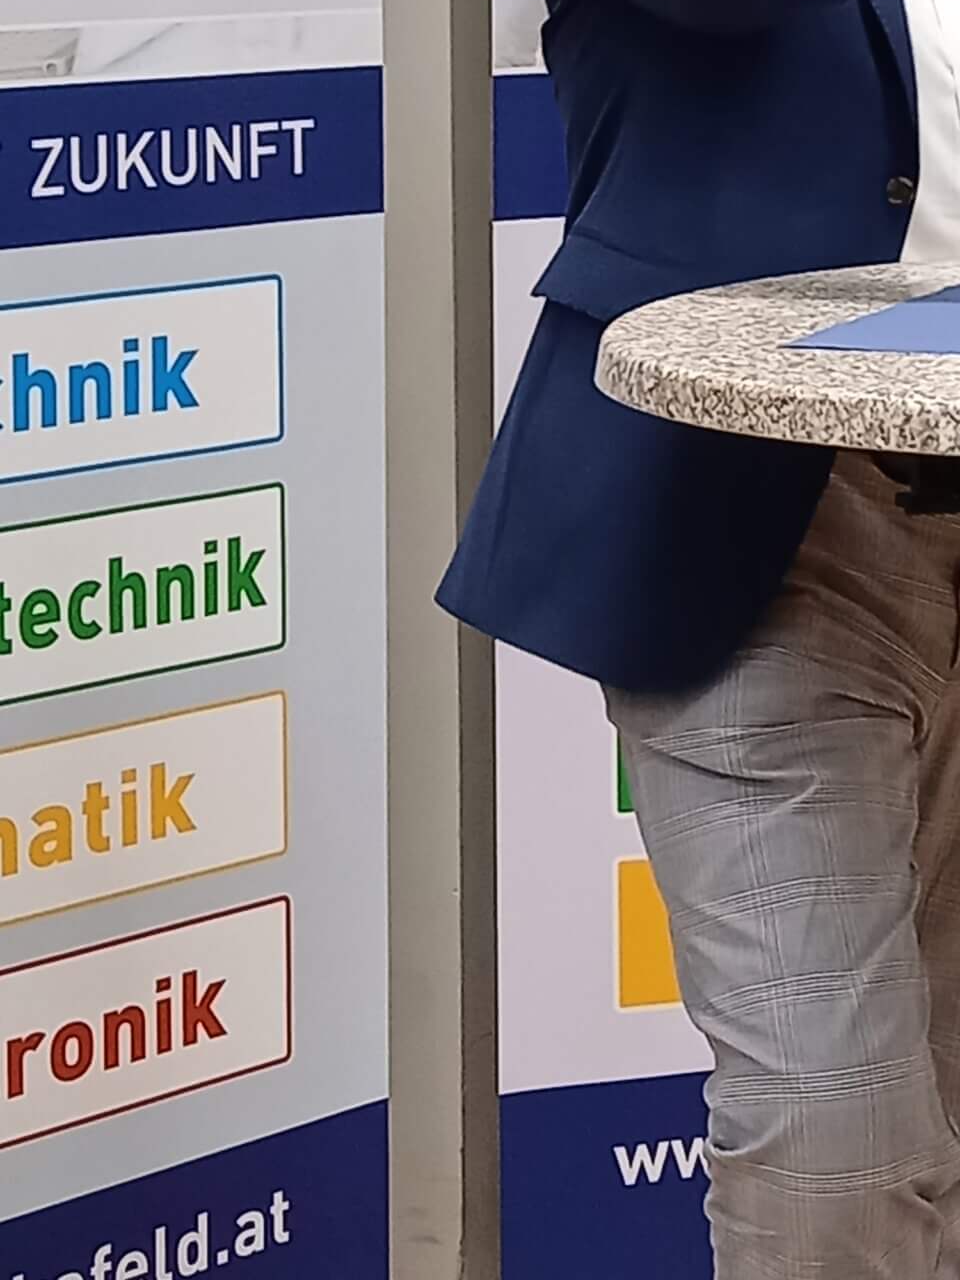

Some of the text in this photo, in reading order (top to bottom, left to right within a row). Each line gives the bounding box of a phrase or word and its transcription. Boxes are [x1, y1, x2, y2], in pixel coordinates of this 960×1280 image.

[31, 118, 315, 198] ZUKUNFT
[0, 335, 200, 433] hnik
[6, 970, 228, 1099] ronik
